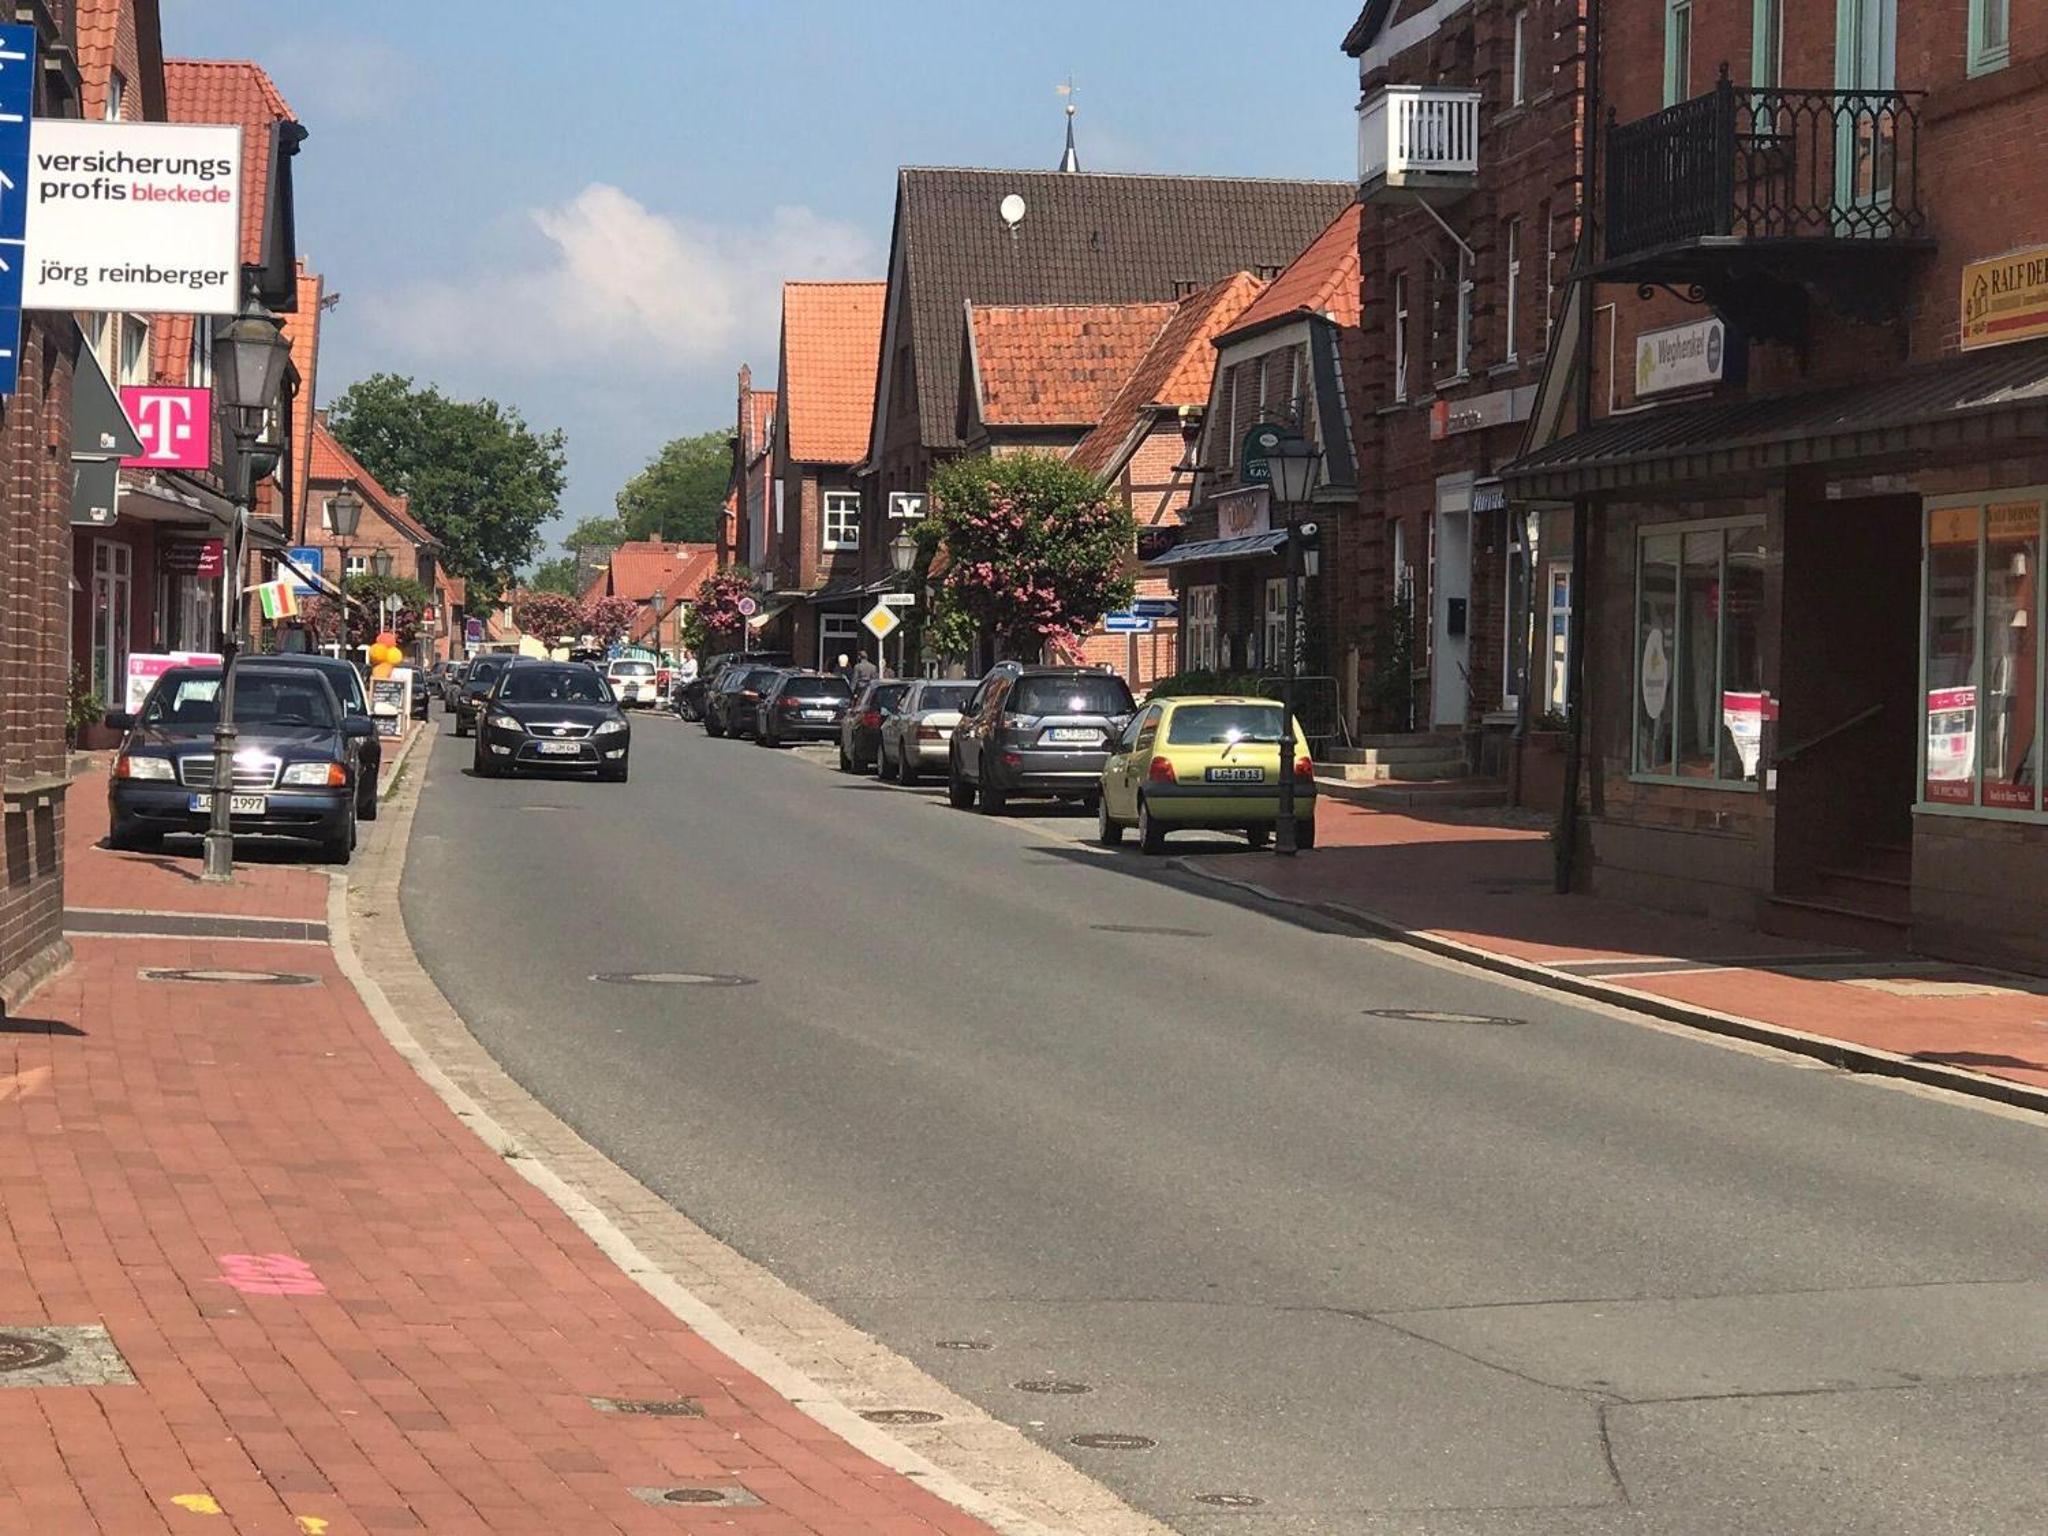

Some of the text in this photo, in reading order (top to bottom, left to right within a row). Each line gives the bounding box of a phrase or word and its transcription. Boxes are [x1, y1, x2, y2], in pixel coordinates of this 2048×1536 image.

[37, 151, 231, 181] versicherungs
[40, 178, 231, 204] profis bleckede
[39, 259, 229, 289] jörg reinberger
[1992, 264, 2025, 295] RALF
[232, 798, 263, 809] 1997
